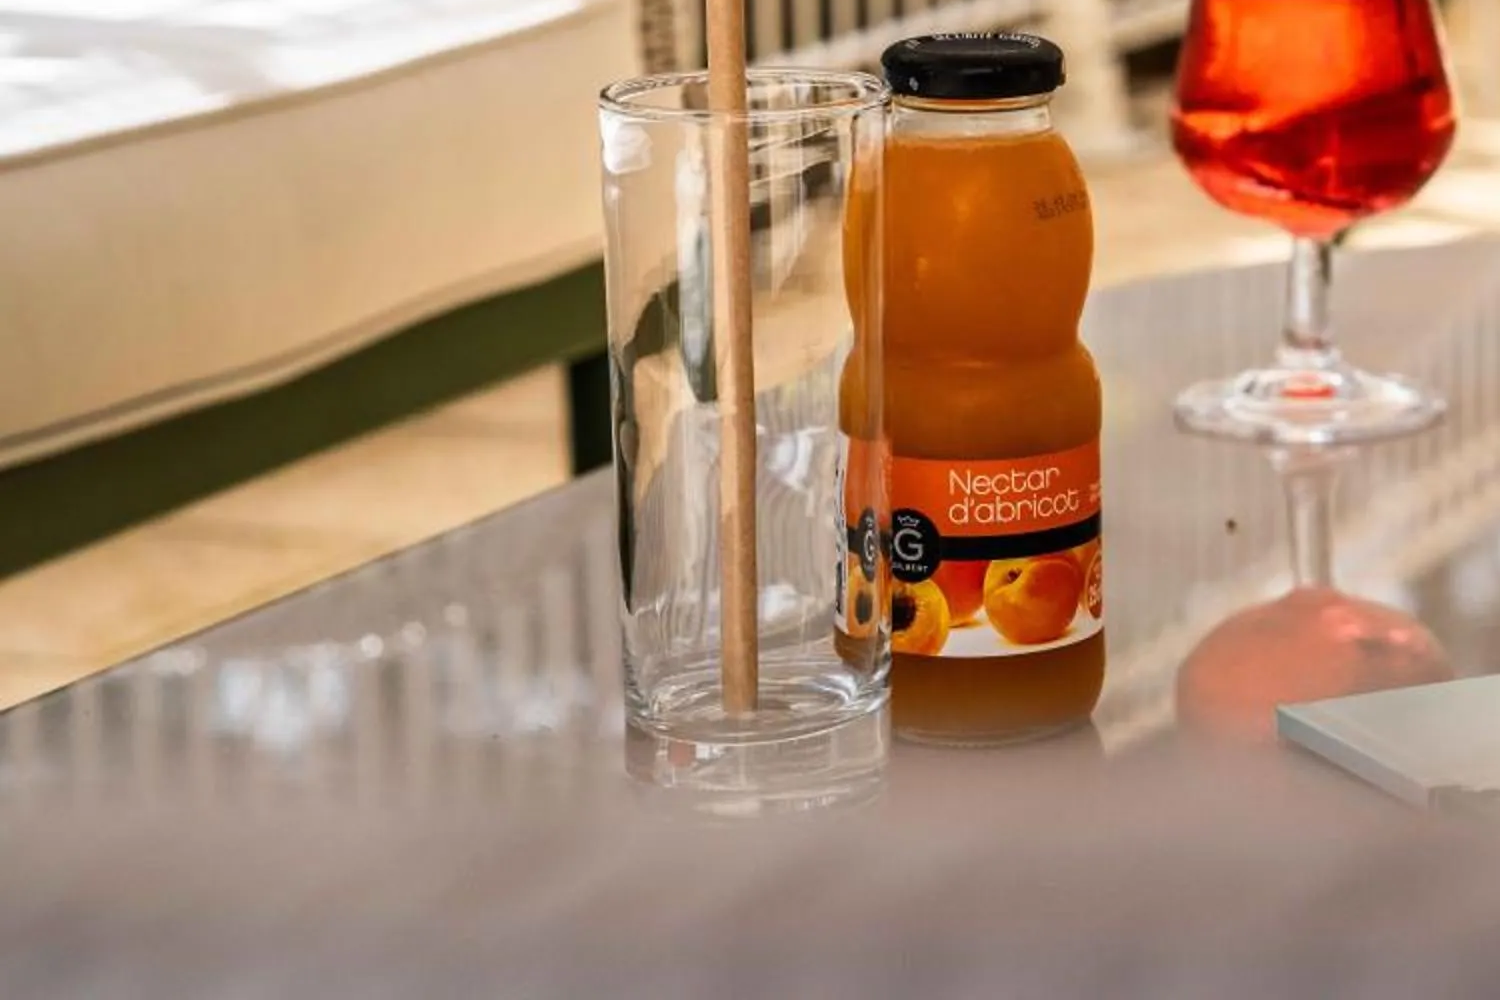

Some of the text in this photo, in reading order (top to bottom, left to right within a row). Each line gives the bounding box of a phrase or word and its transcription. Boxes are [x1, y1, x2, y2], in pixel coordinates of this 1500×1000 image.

[948, 466, 1060, 496] Nectar
[948, 489, 1080, 525] d'abricot
[893, 527, 923, 561] G
